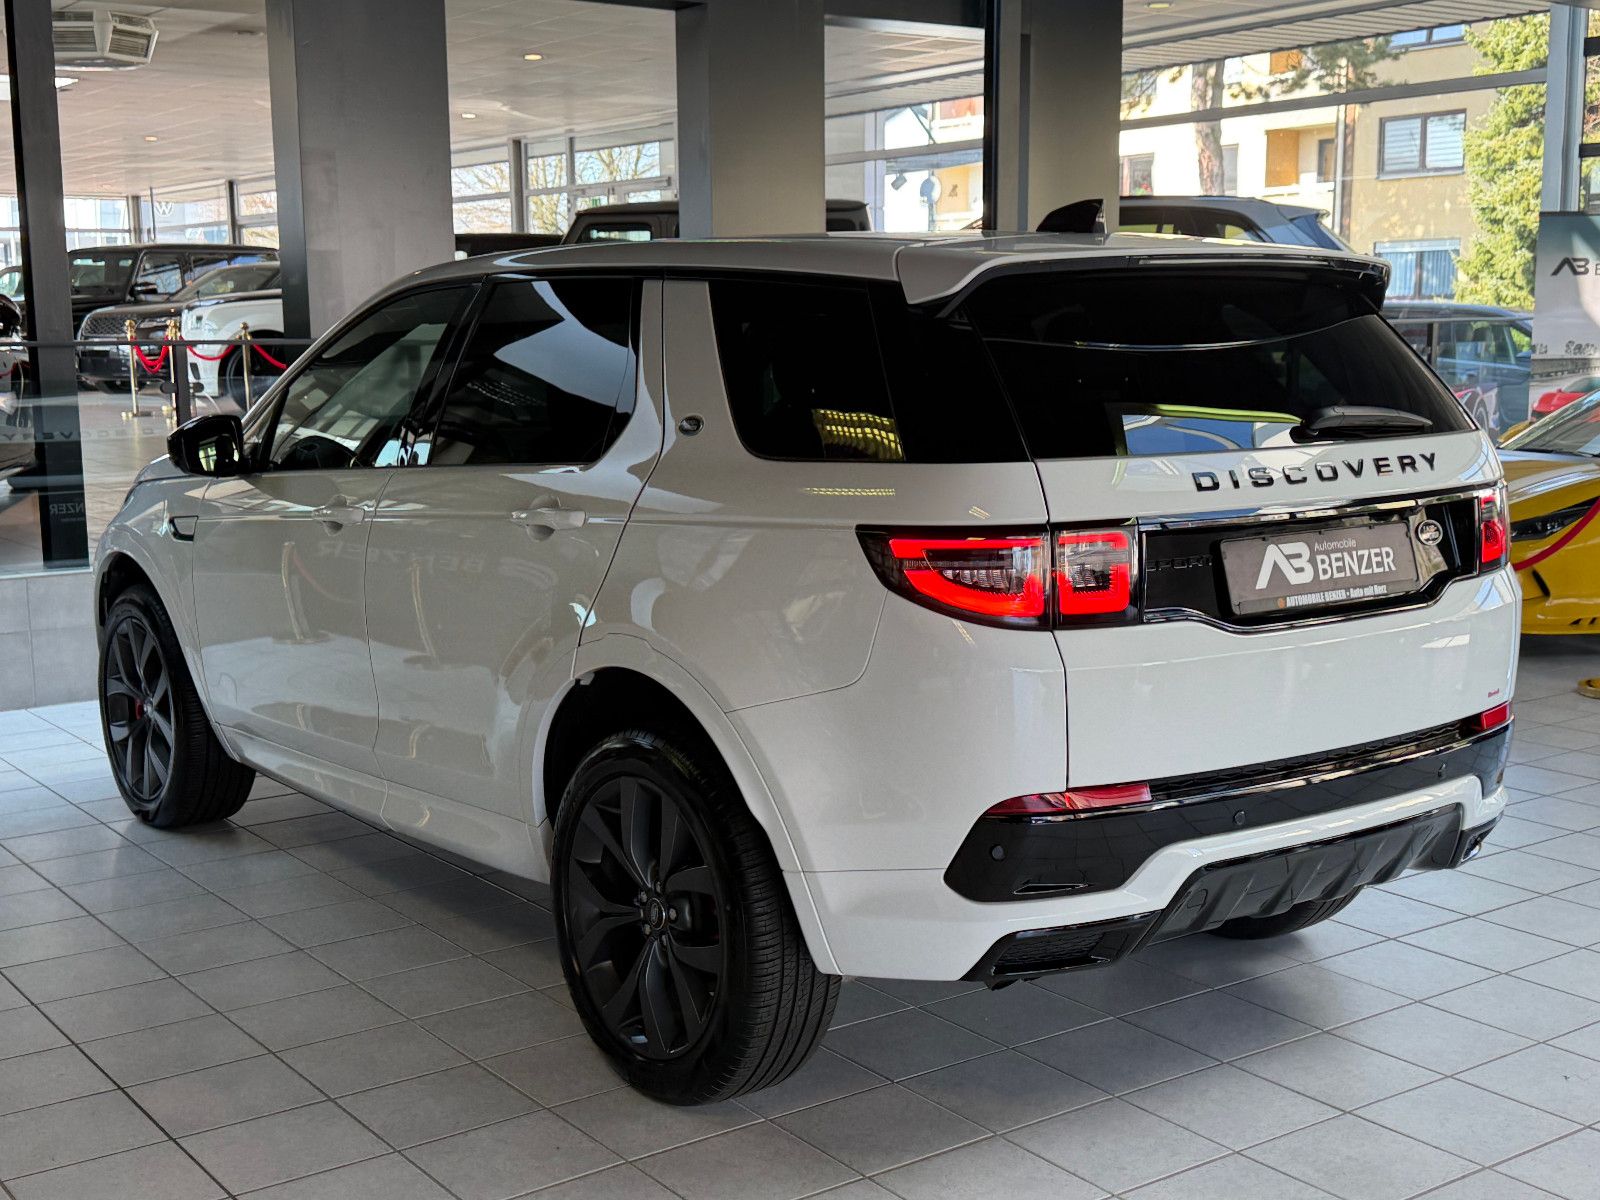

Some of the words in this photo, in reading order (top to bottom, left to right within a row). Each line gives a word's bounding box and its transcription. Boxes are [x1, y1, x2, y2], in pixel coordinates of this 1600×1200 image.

[1192, 453, 1436, 492] DISCOVERY
[1314, 538, 1357, 552] Automobile
[1316, 546, 1397, 581] BENZER
